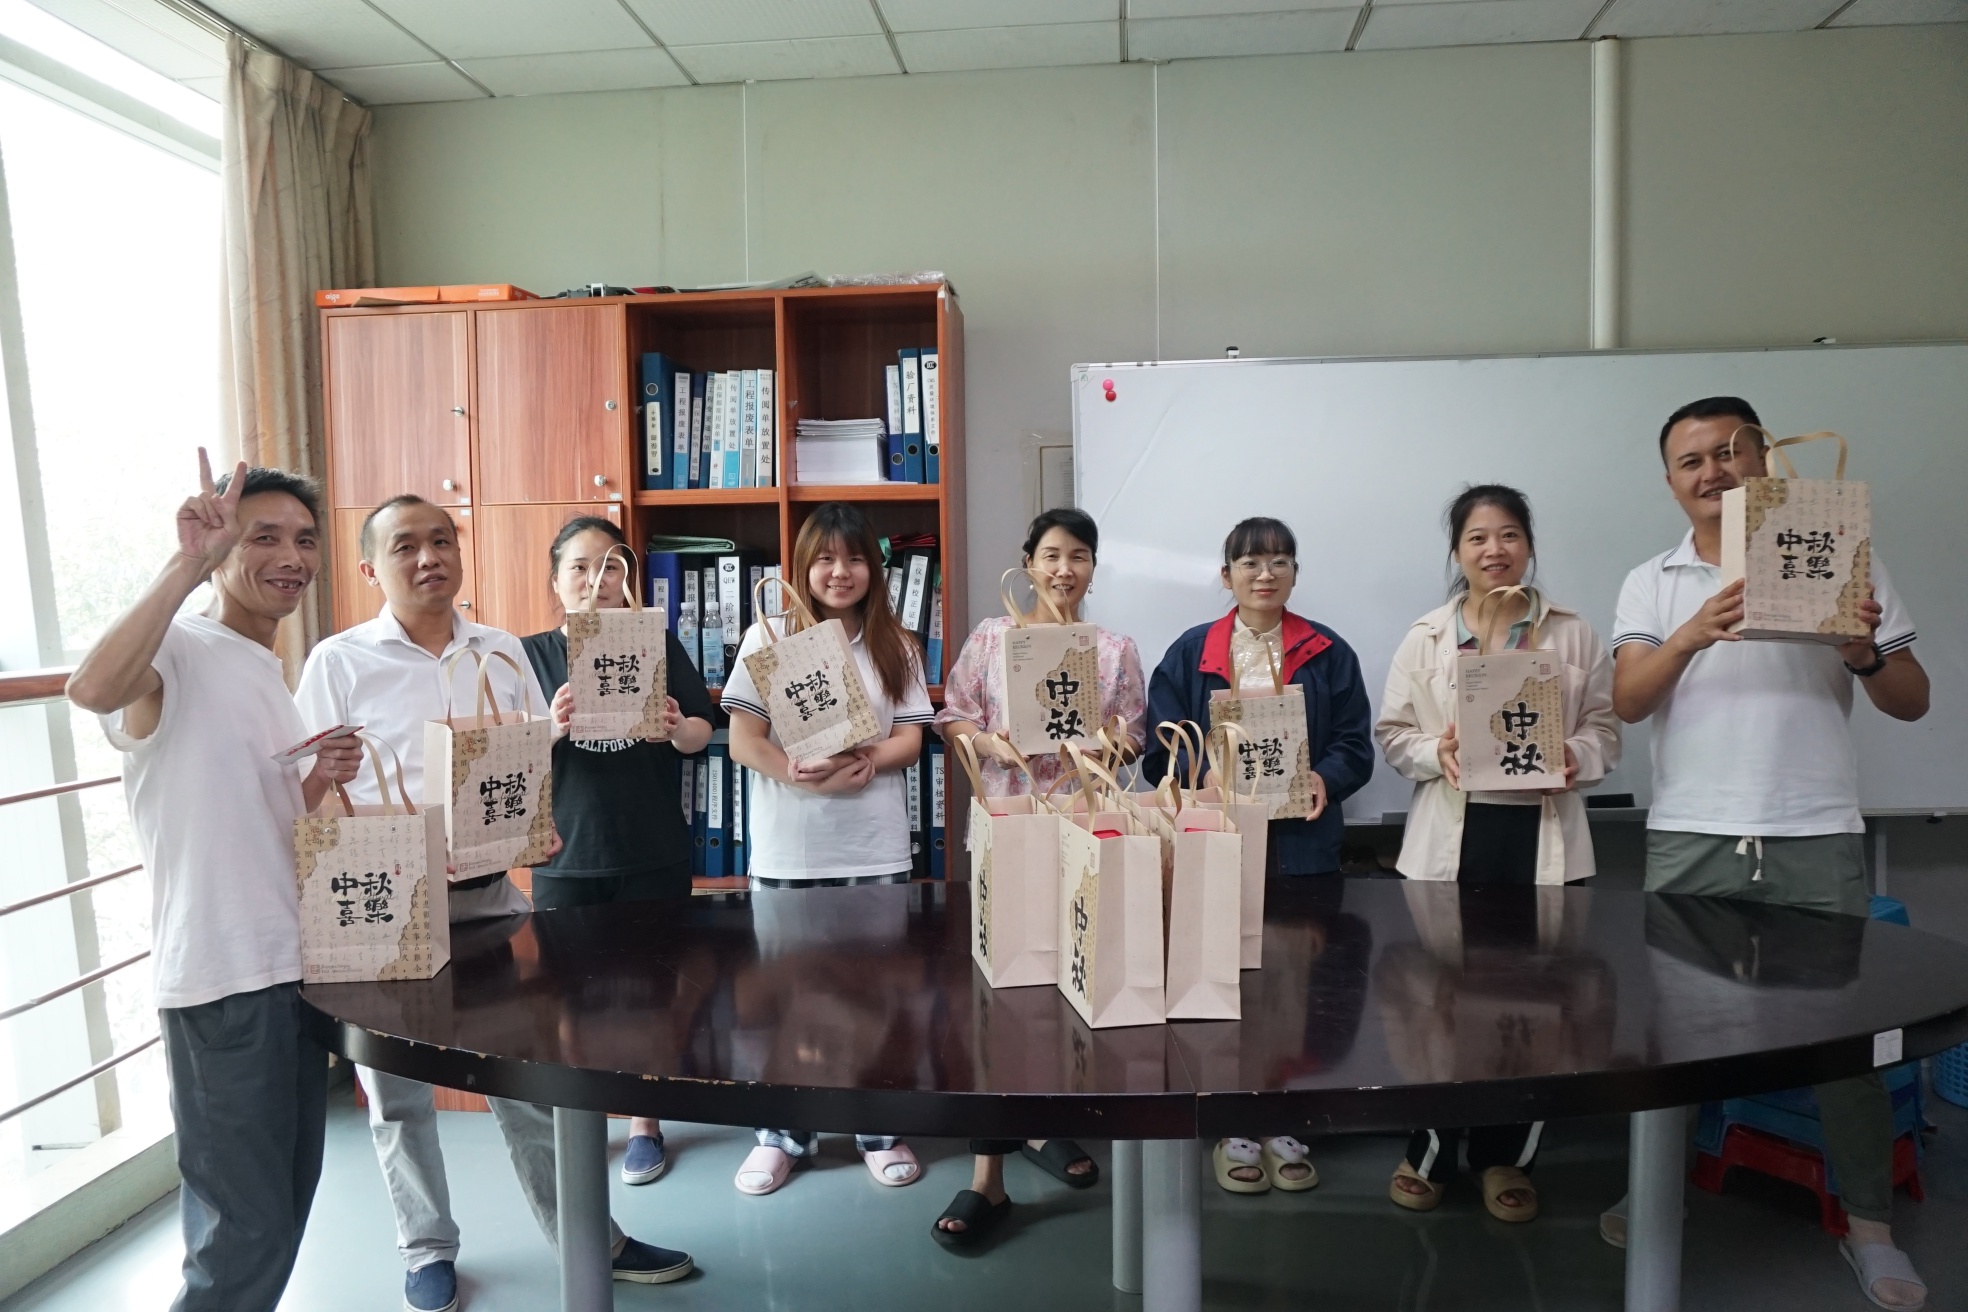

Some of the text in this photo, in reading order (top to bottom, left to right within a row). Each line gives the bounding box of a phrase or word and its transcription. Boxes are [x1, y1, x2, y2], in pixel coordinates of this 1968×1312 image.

[678, 387, 687, 450] 工程报废表单
[729, 384, 737, 449] 传阅单放置处
[744, 380, 755, 447] 工程报废表单
[761, 386, 771, 464] 传阅单放置处
[1777, 528, 1835, 553] 中秋
[908, 567, 922, 628] 仪器校正证书
[594, 654, 640, 673] 中秋
[785, 670, 830, 699] 中秋
[480, 772, 527, 798] 中秋
[331, 872, 393, 896] 中秋
